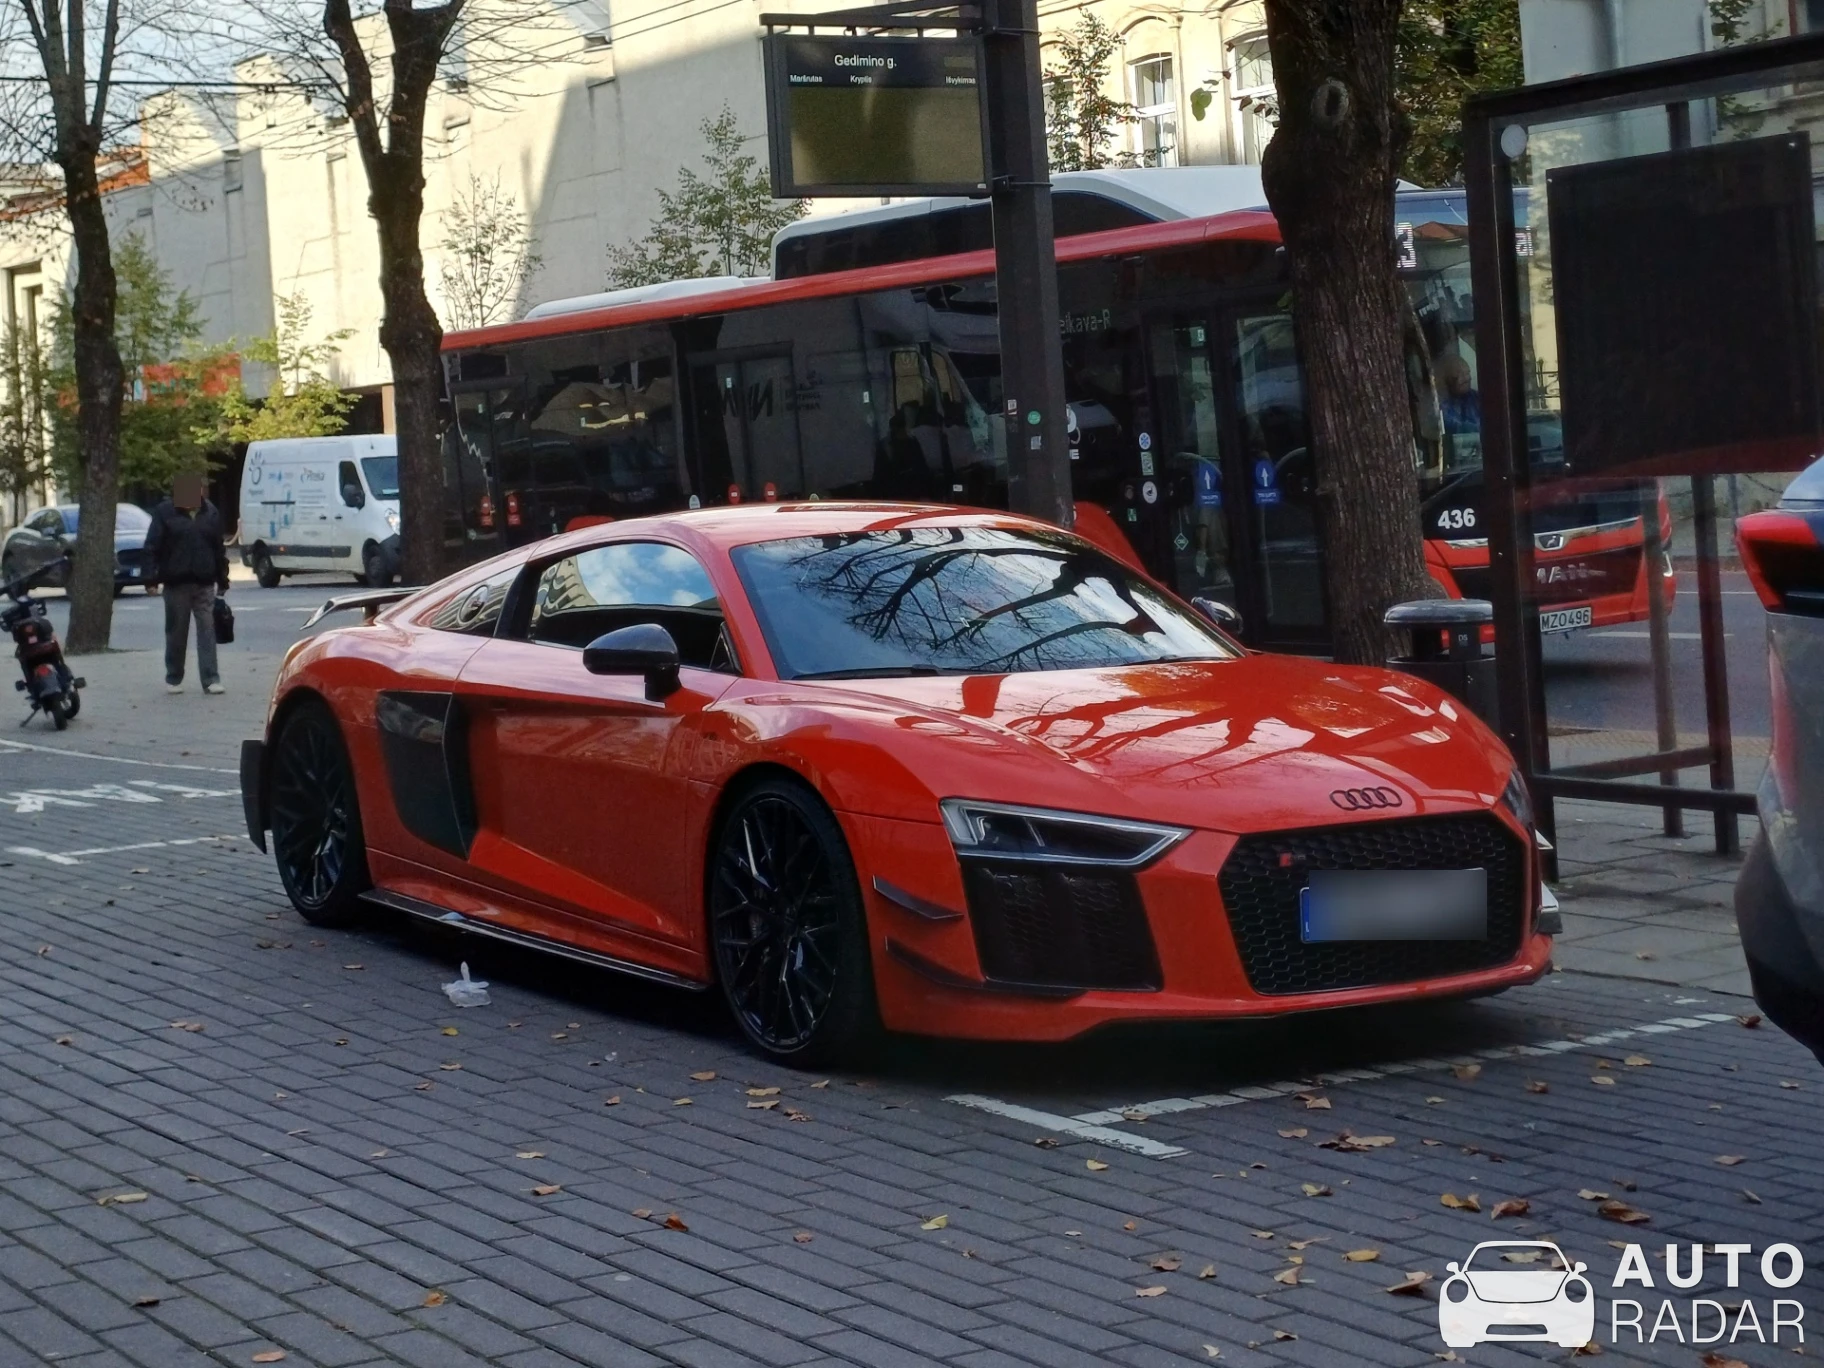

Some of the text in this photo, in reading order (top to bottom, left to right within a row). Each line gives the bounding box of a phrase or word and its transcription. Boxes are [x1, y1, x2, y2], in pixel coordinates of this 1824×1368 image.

[834, 54, 898, 69] Gedimino g.
[1437, 507, 1476, 530] 436
[1541, 608, 1590, 629] MZO496
